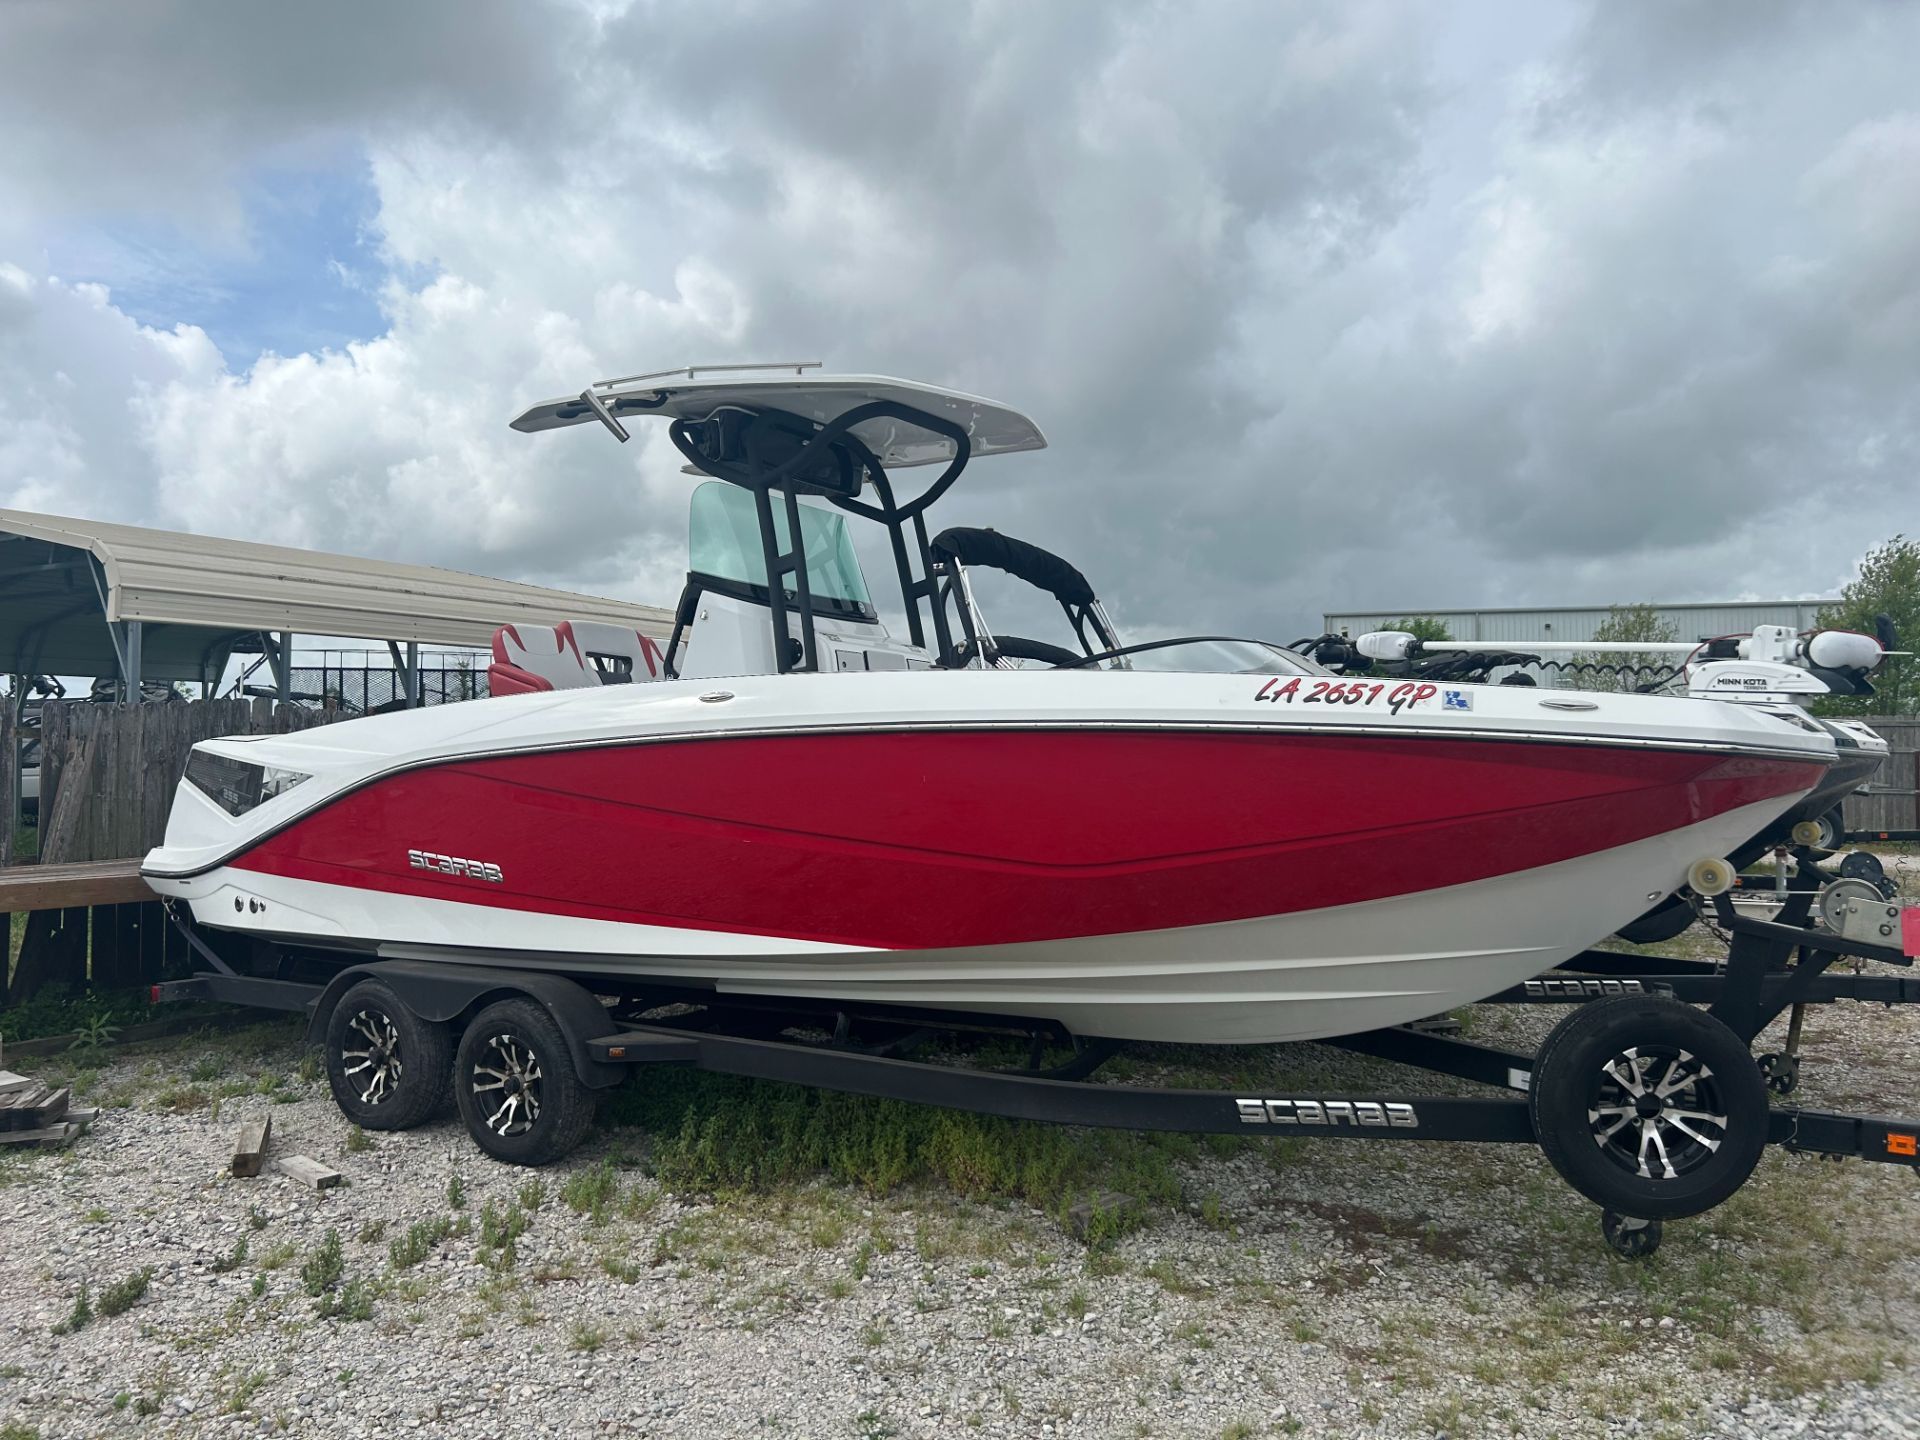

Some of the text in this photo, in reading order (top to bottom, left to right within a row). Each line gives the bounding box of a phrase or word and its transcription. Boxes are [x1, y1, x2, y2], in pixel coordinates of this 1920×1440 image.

[1254, 678, 1438, 716] LA 2651 GP
[1743, 678, 1767, 686] KOTA
[407, 848, 504, 883] SCARAB
[1235, 1098, 1420, 1128] SCARAB
